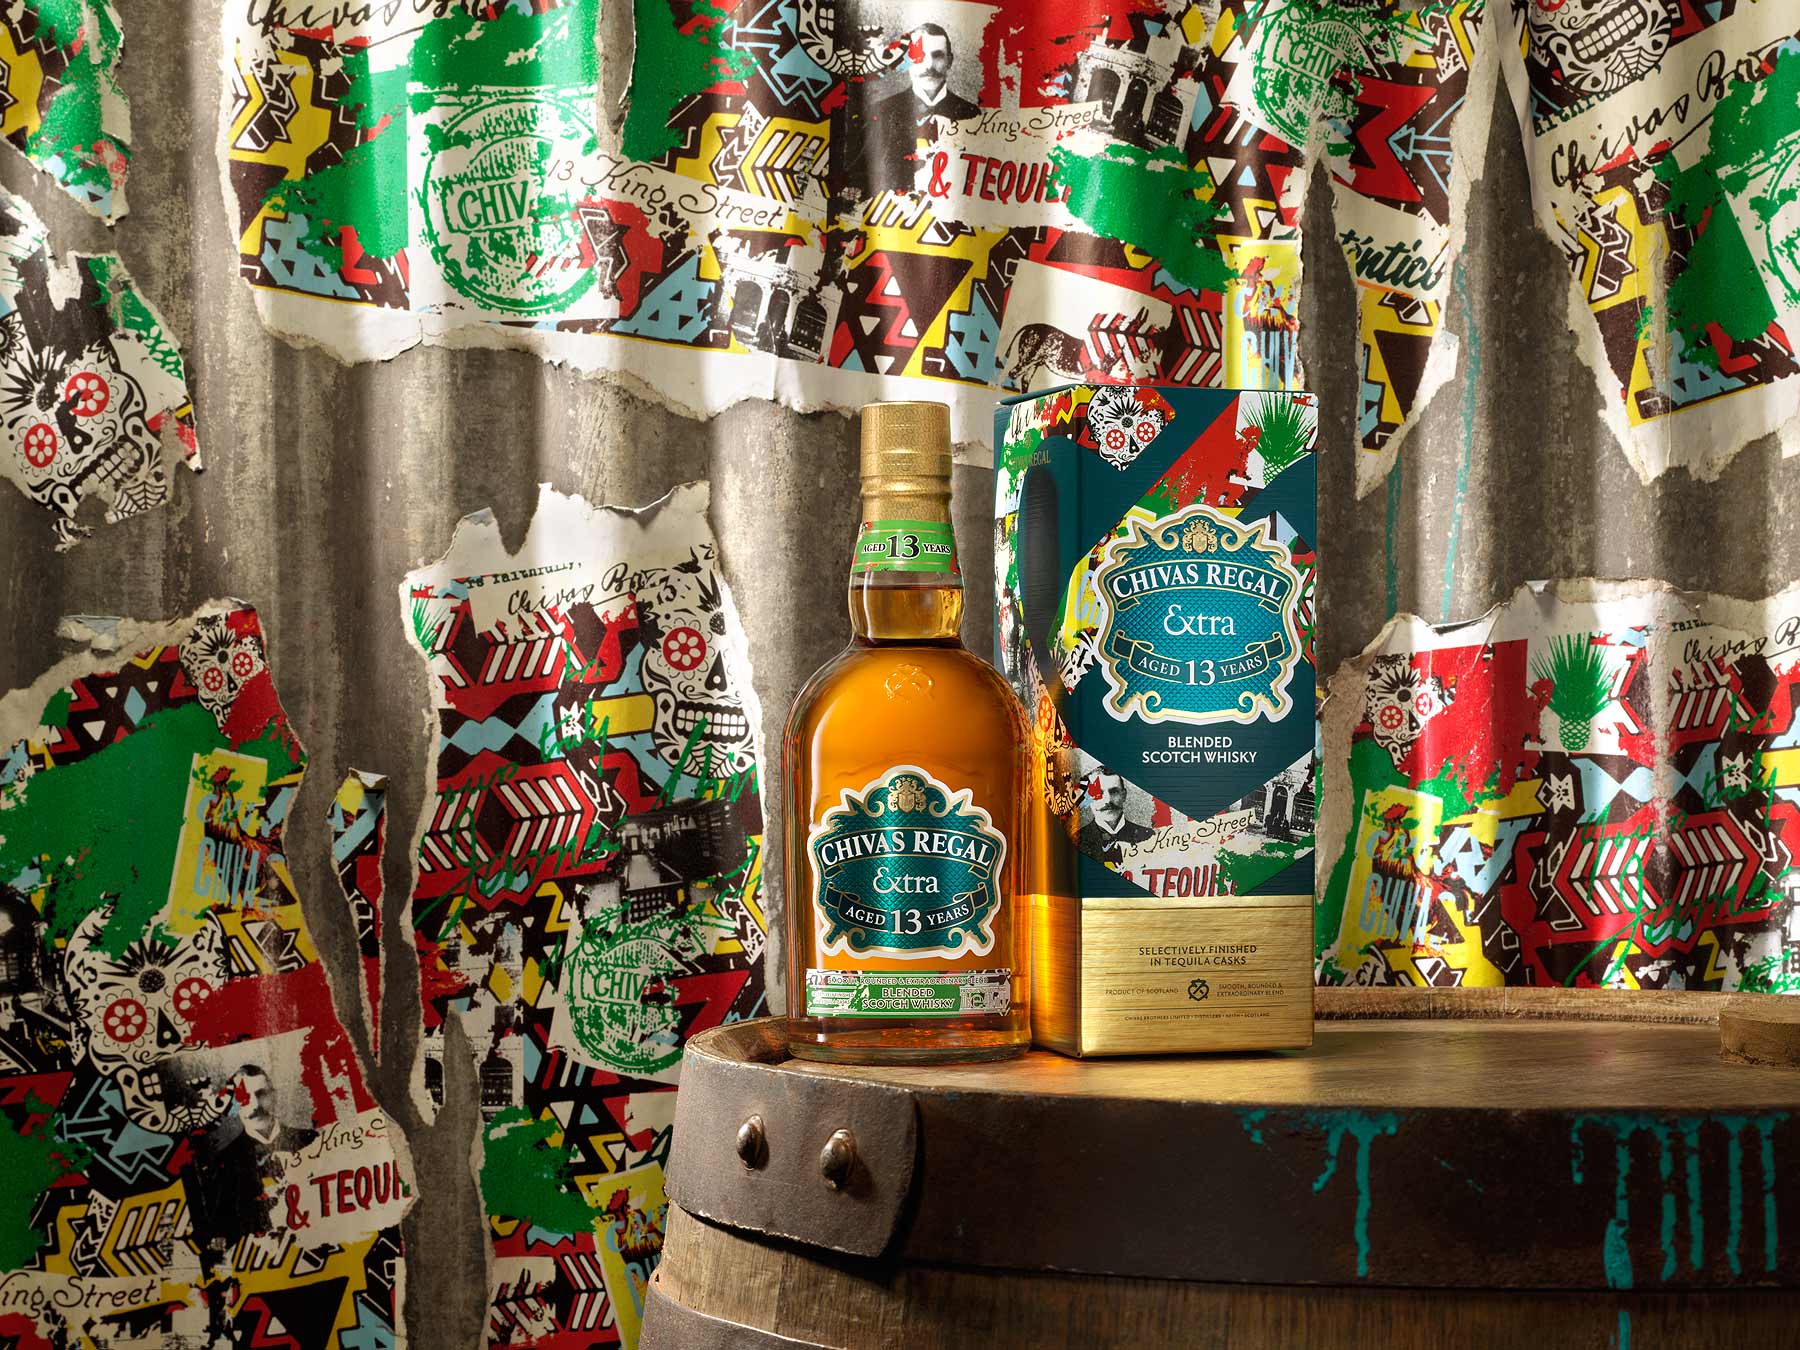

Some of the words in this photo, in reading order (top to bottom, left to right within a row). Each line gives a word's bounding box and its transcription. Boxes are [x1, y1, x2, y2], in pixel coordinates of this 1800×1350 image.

[940, 121, 959, 136] 13
[966, 110, 1020, 142] King
[1551, 93, 1690, 193] Chivas
[547, 159, 575, 181] 13
[581, 155, 667, 215] King
[928, 151, 952, 199] &
[887, 534, 920, 559] 13
[922, 543, 951, 554] YEARS
[1112, 564, 1199, 598] CHIVAS
[1206, 563, 1282, 600] REGAL
[508, 584, 594, 616] Chivas
[1683, 636, 1768, 664] Chivas
[1138, 656, 1180, 676] AGED
[1184, 659, 1216, 686] 13
[1219, 655, 1263, 677] YEARS
[1142, 751, 1200, 763] SCOTCH
[1204, 751, 1257, 763] WHISKY
[1168, 736, 1233, 748] BLENDED
[821, 831, 905, 866] CHIVAS
[913, 831, 991, 866] REGAL
[1123, 843, 1139, 858] 13
[1144, 827, 1191, 852] King
[846, 906, 886, 926] AGED
[890, 908, 922, 935] 13
[926, 903, 970, 925] YEARS
[1139, 946, 1206, 956] SELECTIVELY
[1209, 945, 1257, 954] FINISHED
[1150, 958, 1160, 966] IN
[1164, 957, 1210, 967] TEQUILA
[1213, 956, 1246, 965] CASKS
[860, 977, 897, 986] ROUNDED
[882, 988, 935, 998] BLENDED
[862, 999, 908, 1009] SCOTCH
[911, 999, 955, 1009] WHISKY
[284, 1152, 302, 1169] 13
[308, 1122, 364, 1159] King
[285, 1184, 311, 1230] &
